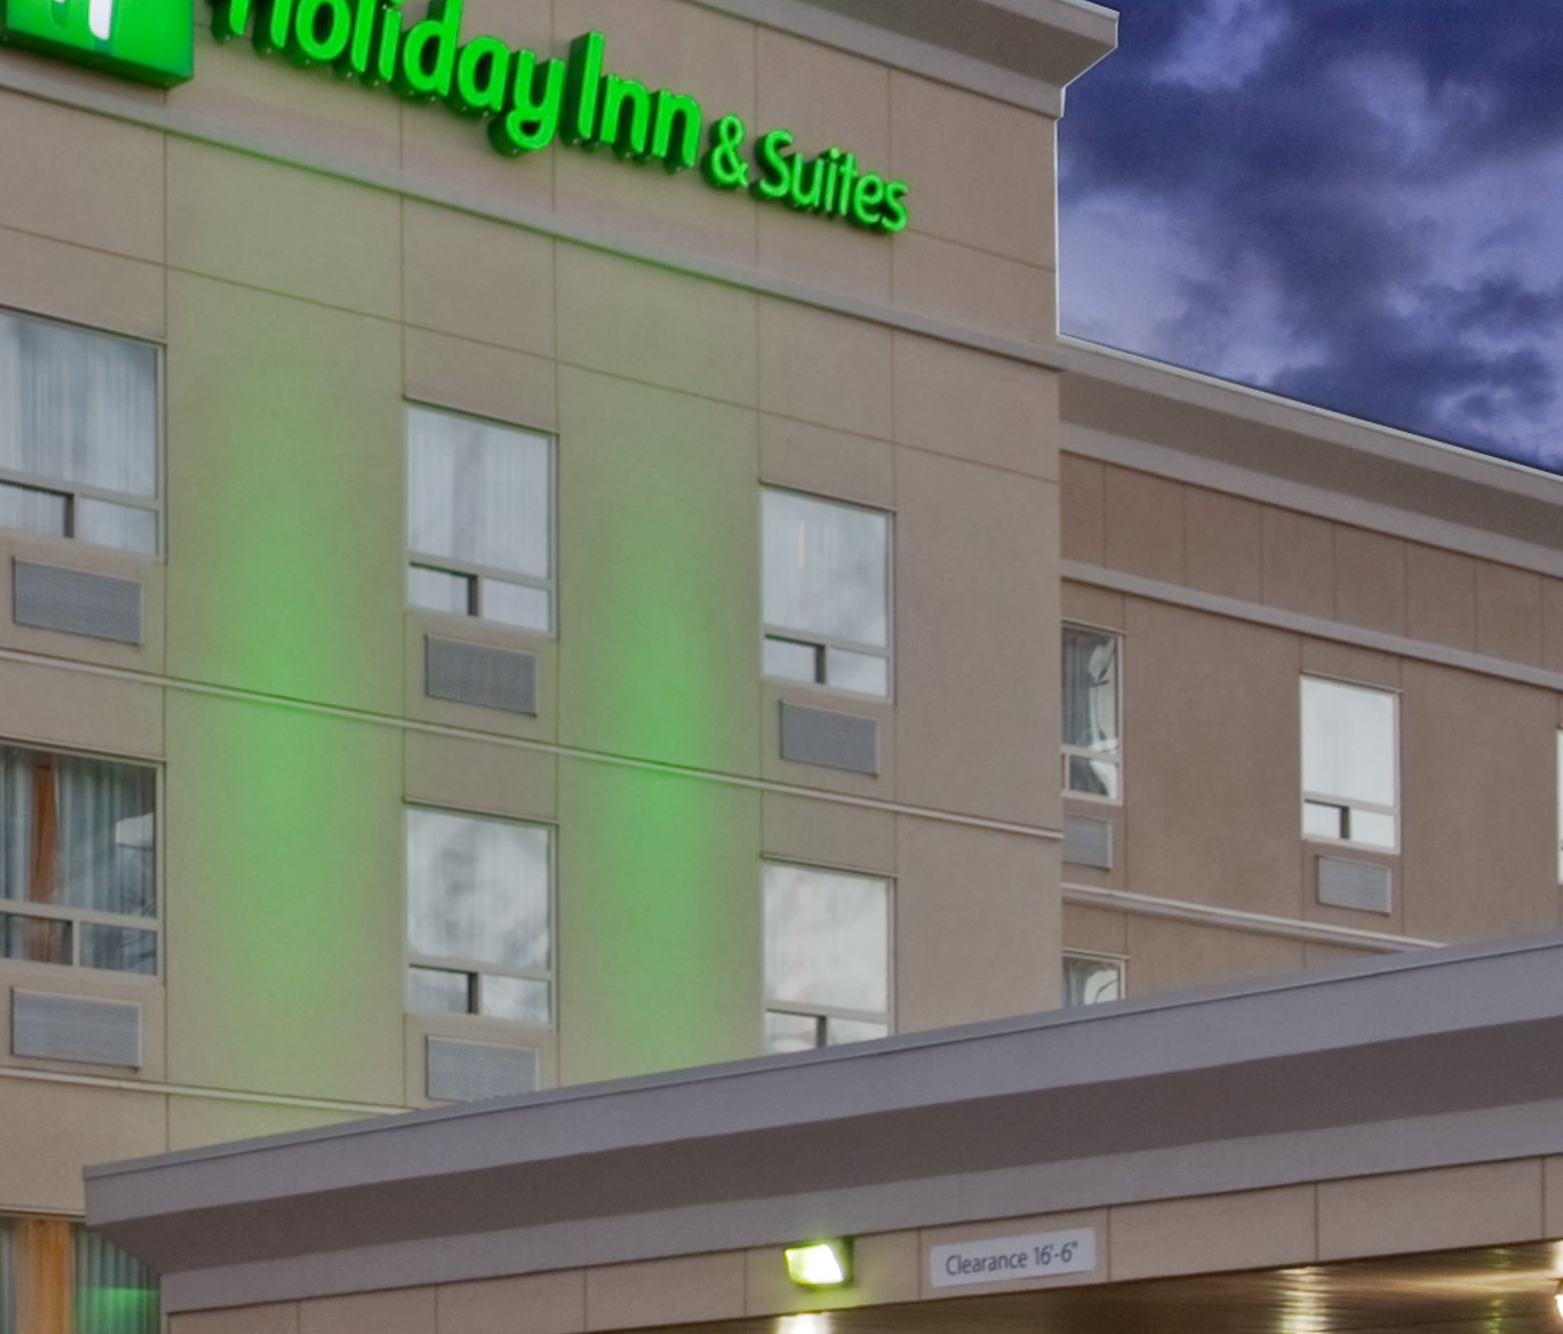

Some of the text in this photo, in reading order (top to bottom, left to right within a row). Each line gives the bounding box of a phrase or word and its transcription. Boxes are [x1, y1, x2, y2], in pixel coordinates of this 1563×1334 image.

[575, 30, 702, 167] Inn
[709, 113, 749, 188] &
[757, 128, 908, 233] Suites
[945, 1250, 1028, 1276] Clearance
